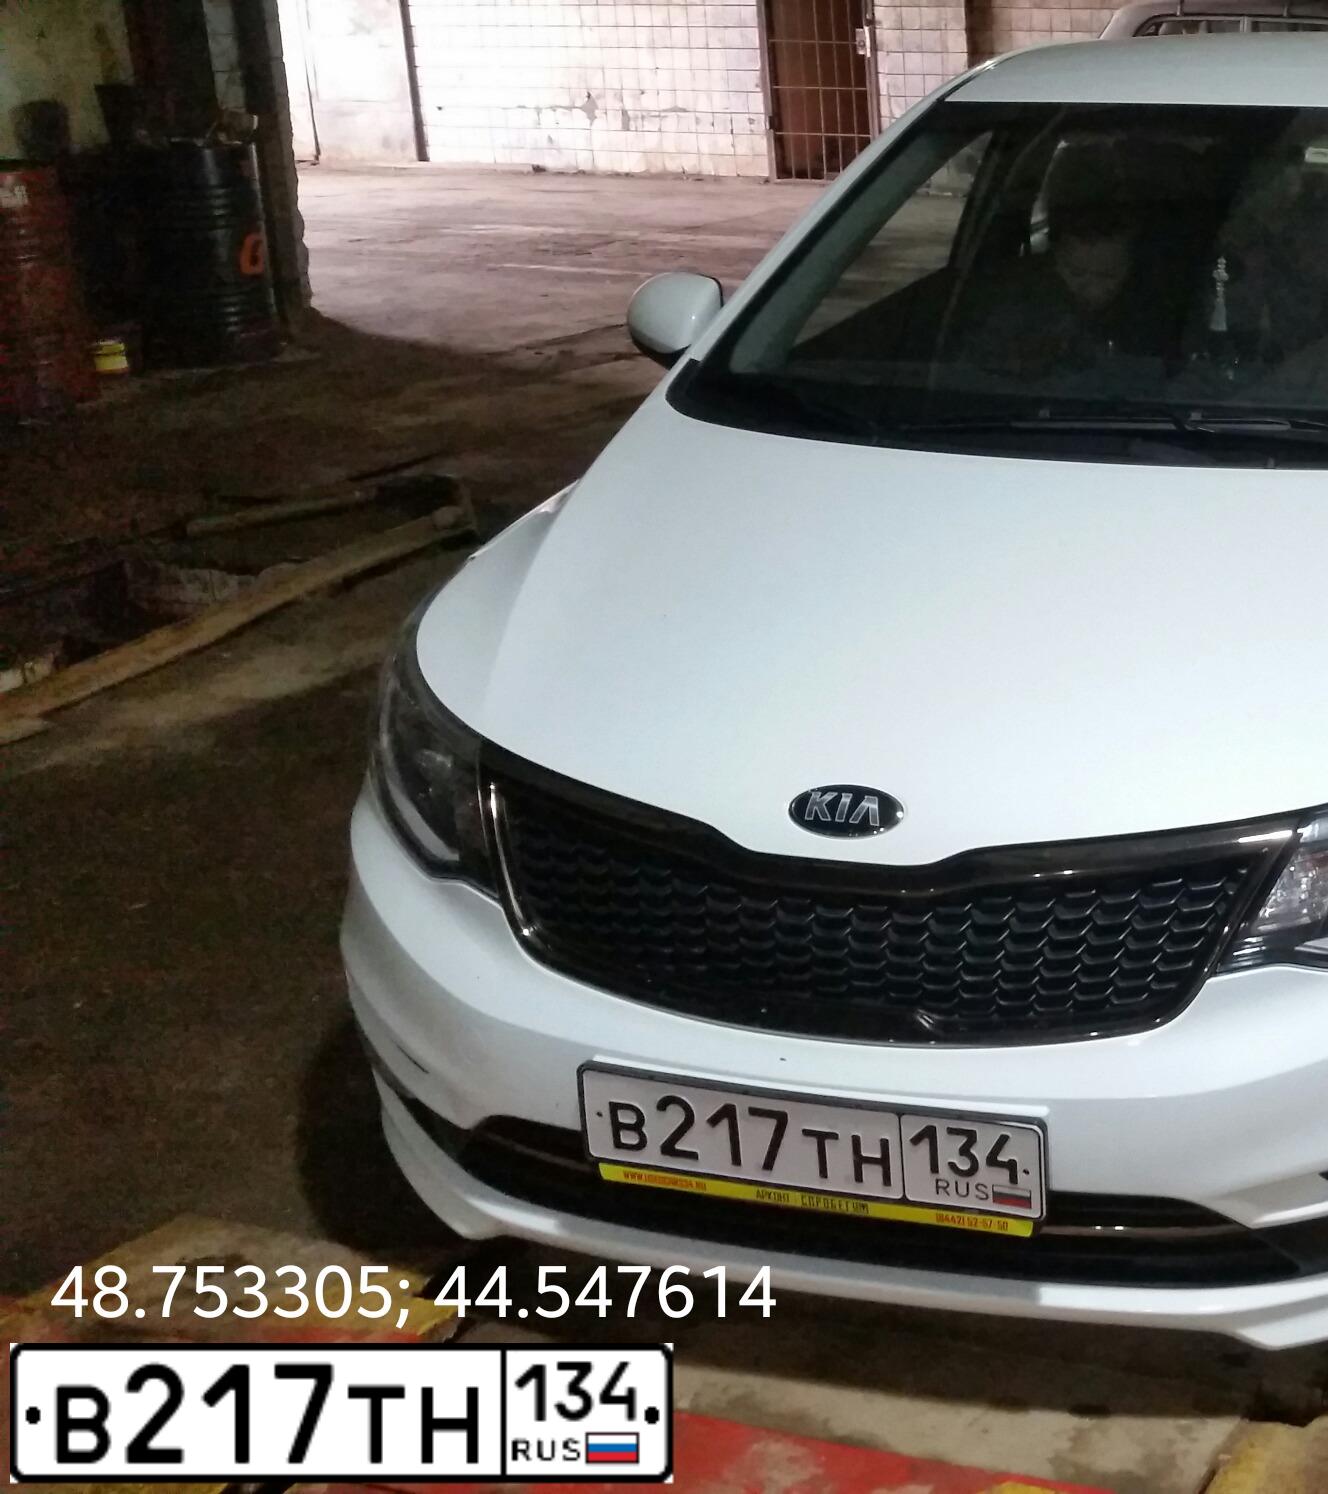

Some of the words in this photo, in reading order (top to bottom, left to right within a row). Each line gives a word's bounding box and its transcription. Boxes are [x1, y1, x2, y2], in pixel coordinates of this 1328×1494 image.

[804, 791, 880, 826] KIA
[909, 1124, 1018, 1185] 134
[935, 1178, 989, 1201] RUS
